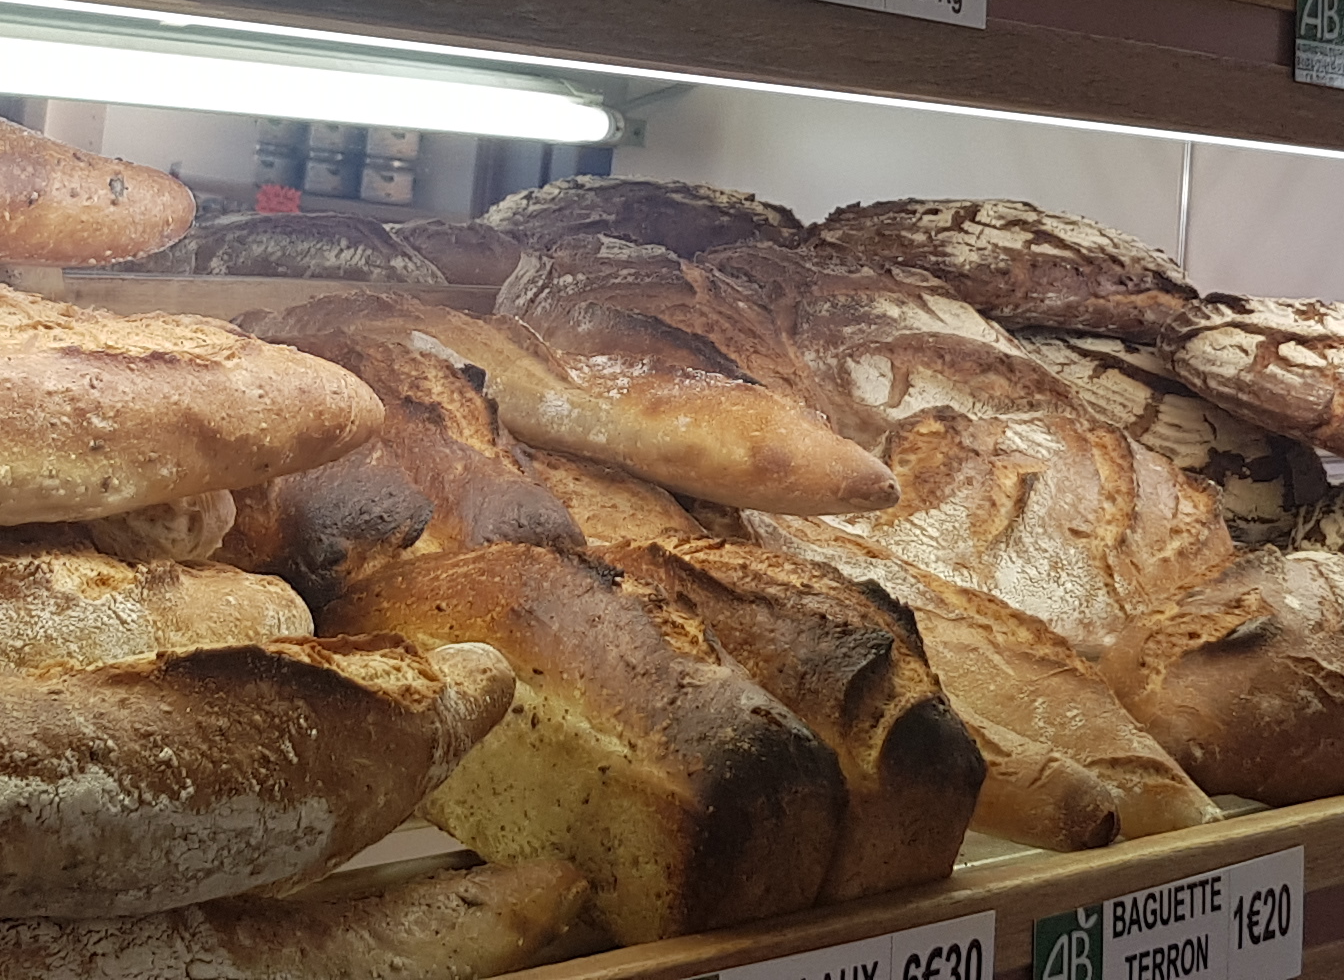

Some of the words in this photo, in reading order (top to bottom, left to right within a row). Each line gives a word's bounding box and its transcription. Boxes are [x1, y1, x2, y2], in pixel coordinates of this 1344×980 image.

[1112, 875, 1222, 940] BAGUETTE
[1233, 883, 1291, 950] 1€20
[1042, 930, 1093, 980] AB
[1124, 933, 1209, 980] TERRON
